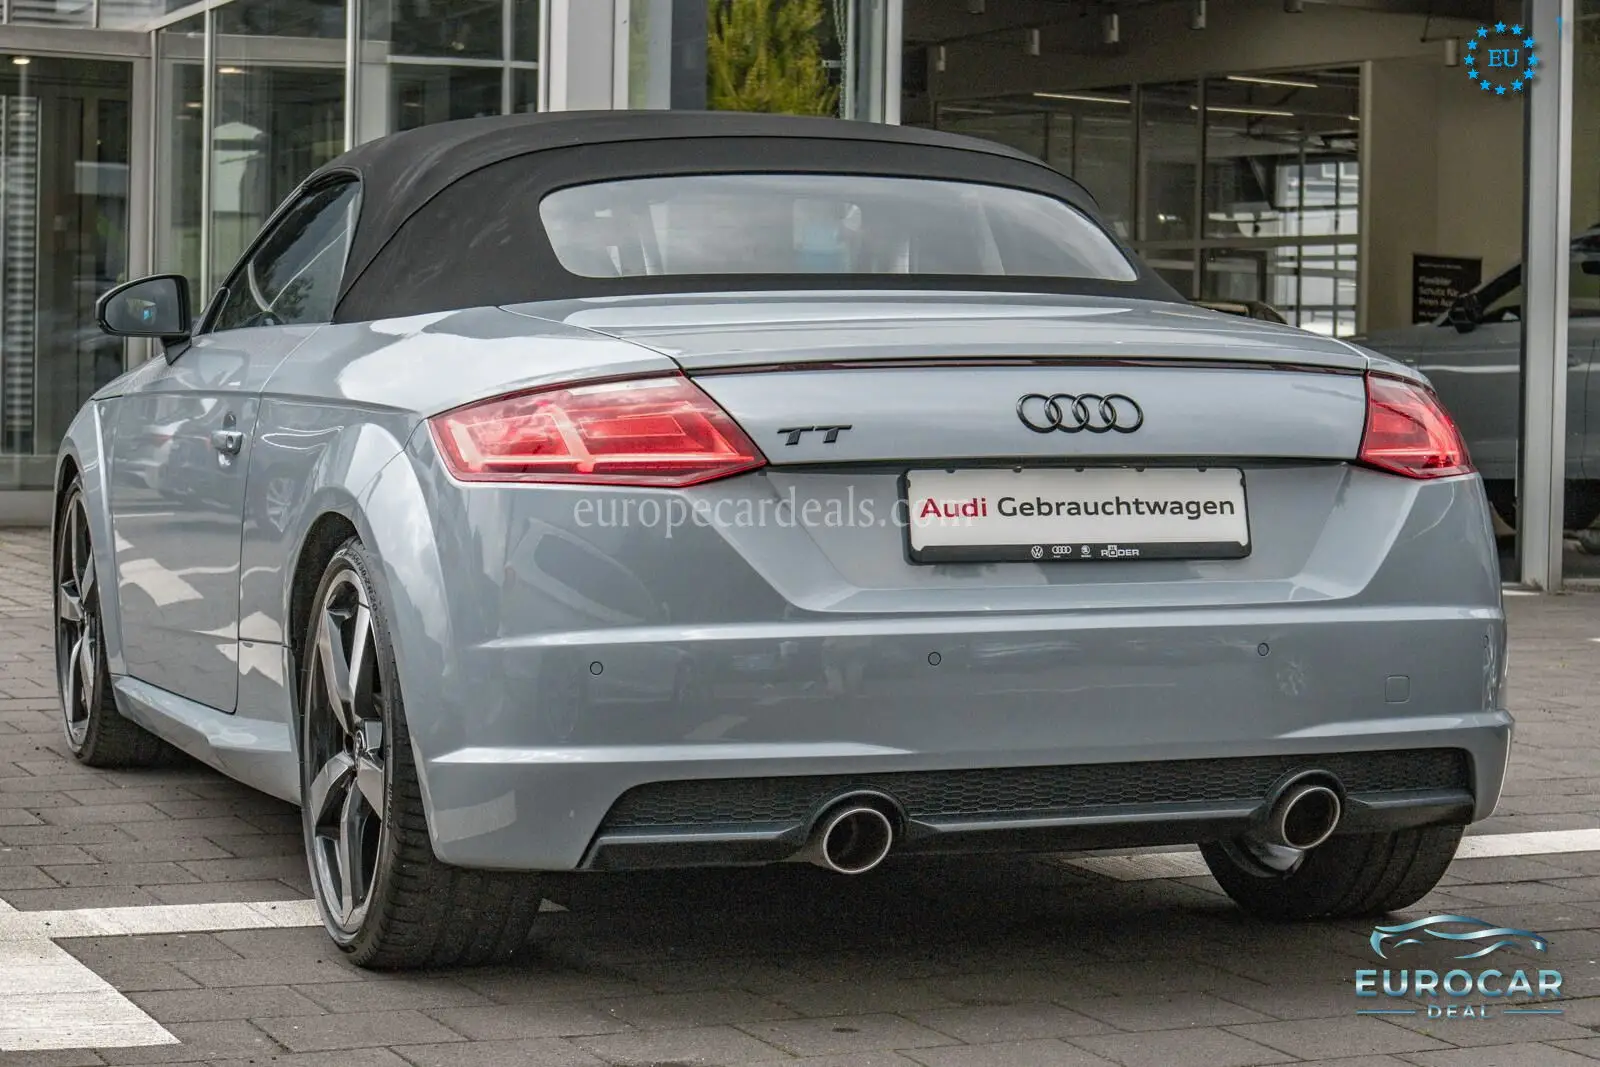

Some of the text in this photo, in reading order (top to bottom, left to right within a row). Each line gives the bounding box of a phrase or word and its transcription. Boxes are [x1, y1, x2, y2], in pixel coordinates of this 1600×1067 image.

[777, 424, 852, 446] TT
[920, 496, 1235, 520] Audi Gebrauchtwagen
